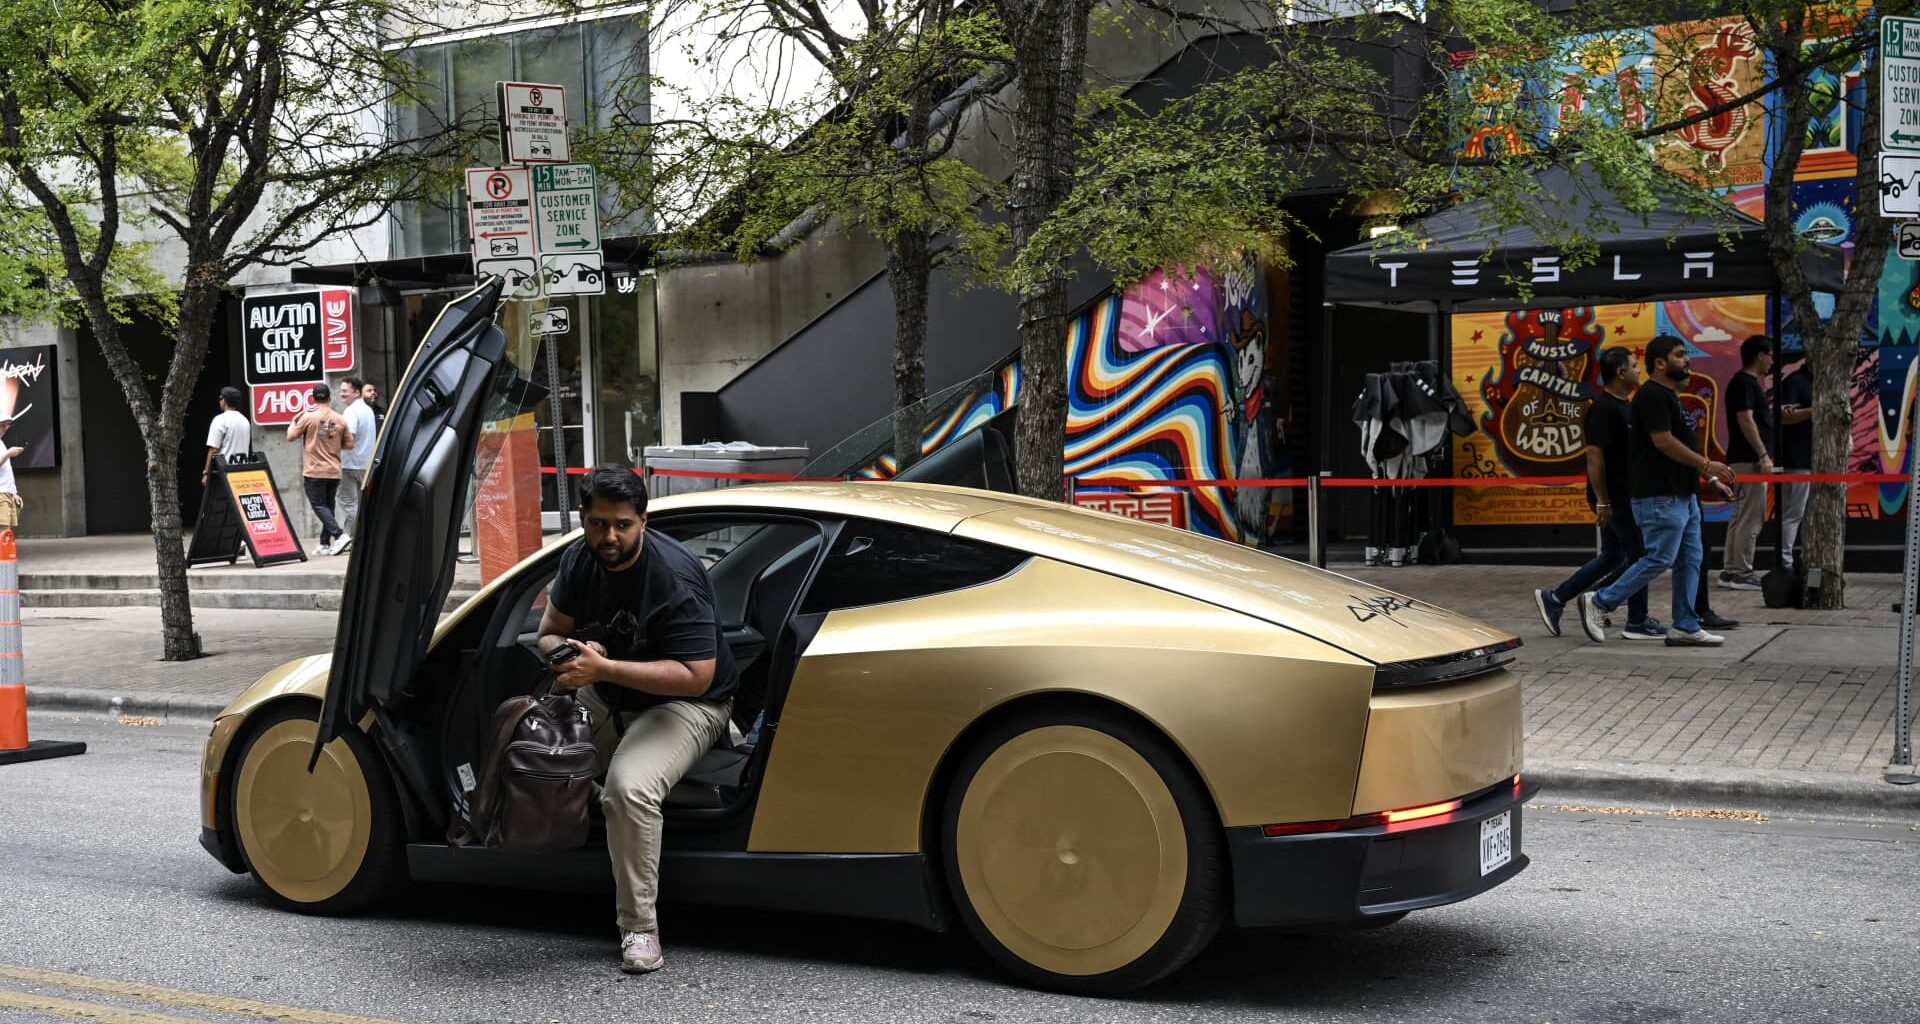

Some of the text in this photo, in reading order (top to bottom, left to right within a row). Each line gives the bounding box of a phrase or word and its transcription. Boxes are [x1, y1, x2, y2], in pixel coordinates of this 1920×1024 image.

[1886, 20, 1900, 44] 15
[1886, 43, 1900, 56] MIN
[1888, 64, 1920, 83] CUSTO
[1900, 108, 1920, 126] ZON
[536, 165, 550, 182] 15
[555, 176, 591, 186] MON-SAT
[537, 181, 551, 191] MIN
[541, 194, 591, 208] CUSTOMER
[547, 209, 587, 222] SERVICE
[556, 224, 581, 237] ZONE
[1379, 251, 1714, 288] TESLA
[249, 302, 316, 329] AUSTIN
[1538, 311, 1561, 323] LIVE
[262, 326, 304, 350] CITY
[326, 299, 348, 359] LIVE
[1528, 341, 1577, 359] MUSIC
[1519, 367, 1580, 398] CAPITAL
[1522, 400, 1581, 418] OF THE
[1516, 422, 1582, 456] WORLD
[247, 504, 261, 512] CITY
